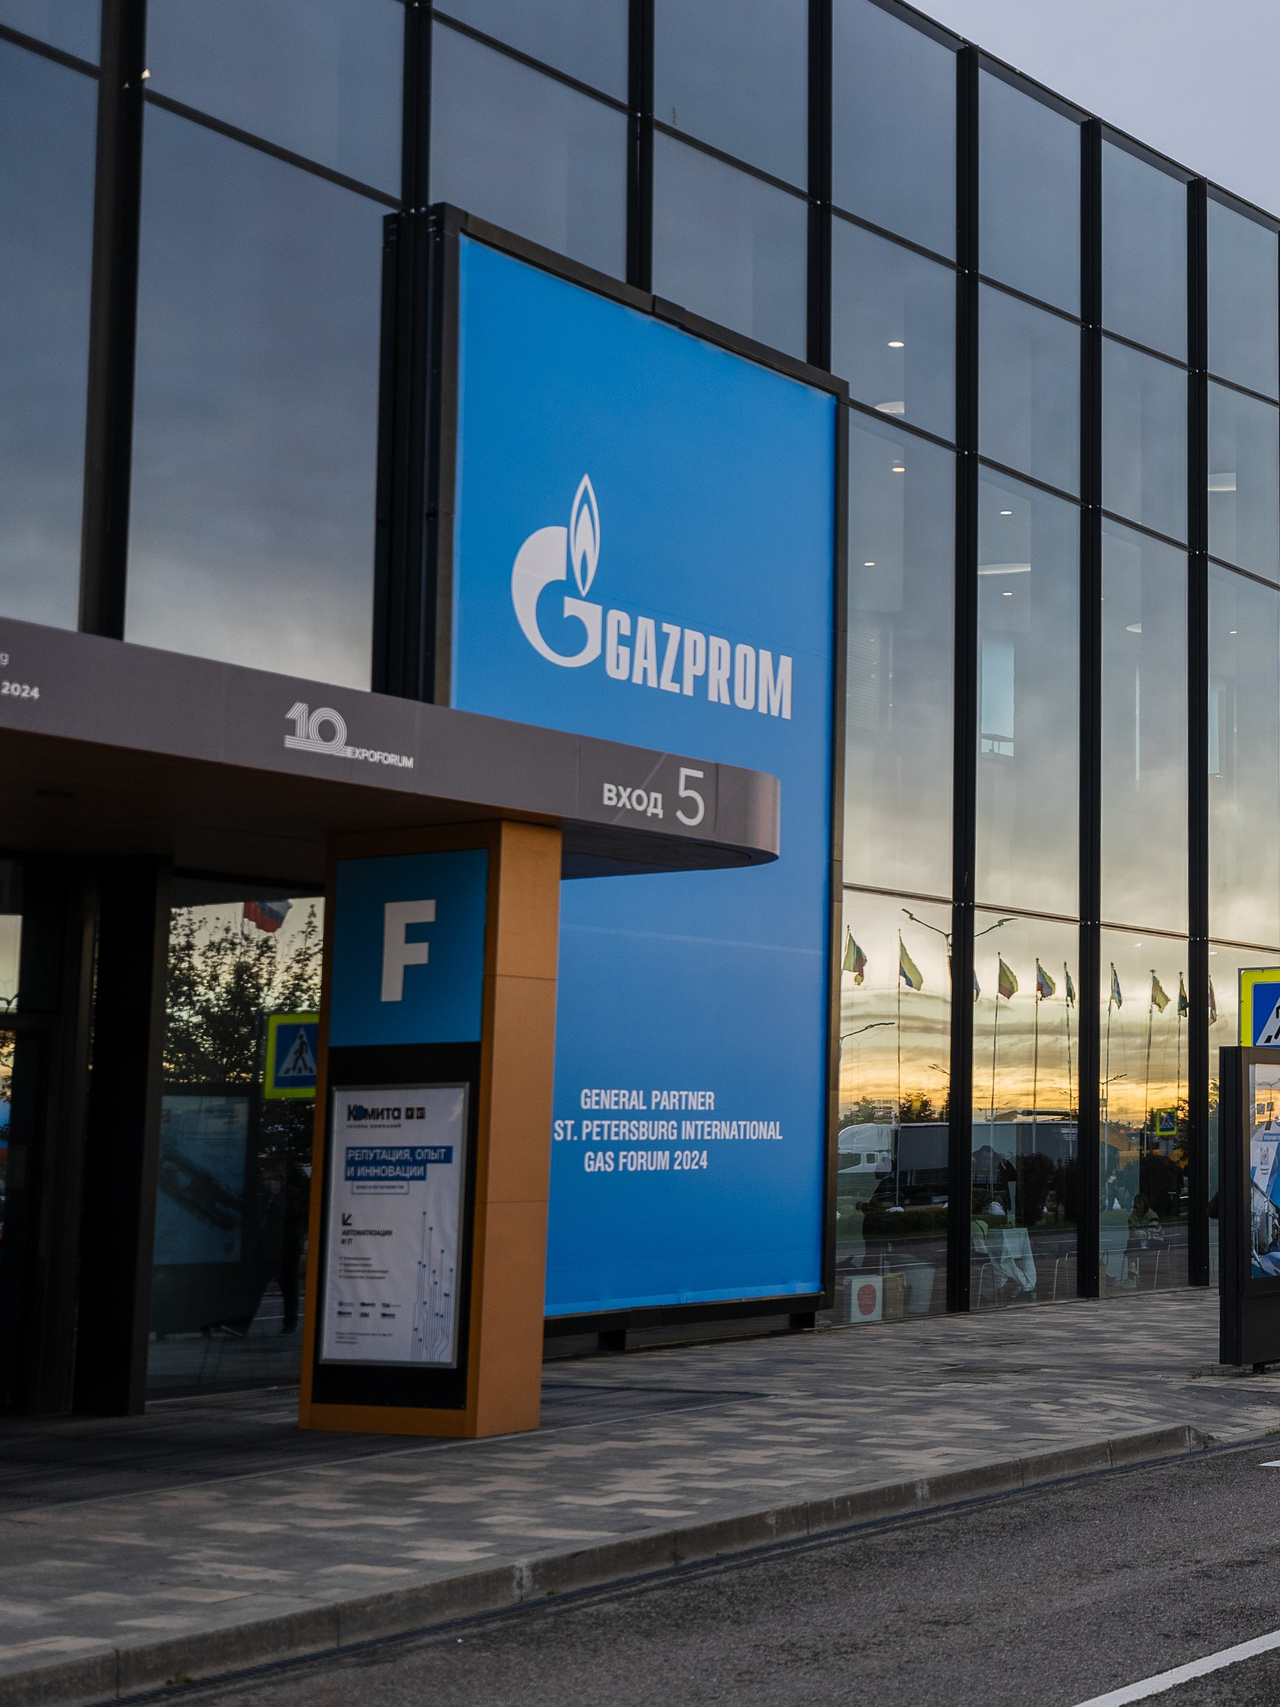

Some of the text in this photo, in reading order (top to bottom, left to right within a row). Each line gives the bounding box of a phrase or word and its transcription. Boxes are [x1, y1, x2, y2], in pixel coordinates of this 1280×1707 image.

[605, 608, 793, 720] GAZPROM
[1, 681, 40, 699] 2024
[284, 701, 347, 754] 10
[346, 746, 414, 768] EXPOFORUM
[602, 767, 705, 826] ВХОД 5
[381, 899, 437, 1002] F
[580, 1089, 715, 1110] GENERAL PARTNER
[554, 1120, 783, 1141] ST. PETERSBURG INTERNATIONAL
[347, 1148, 446, 1162] РЕПУТАЦИЯ, ОПЫТ
[584, 1150, 708, 1172] GAS FORUM 2024
[347, 1165, 425, 1179] И ИННОВАЦИИ
[342, 1229, 393, 1237] АВТОМАТИЗАЦИЯ
